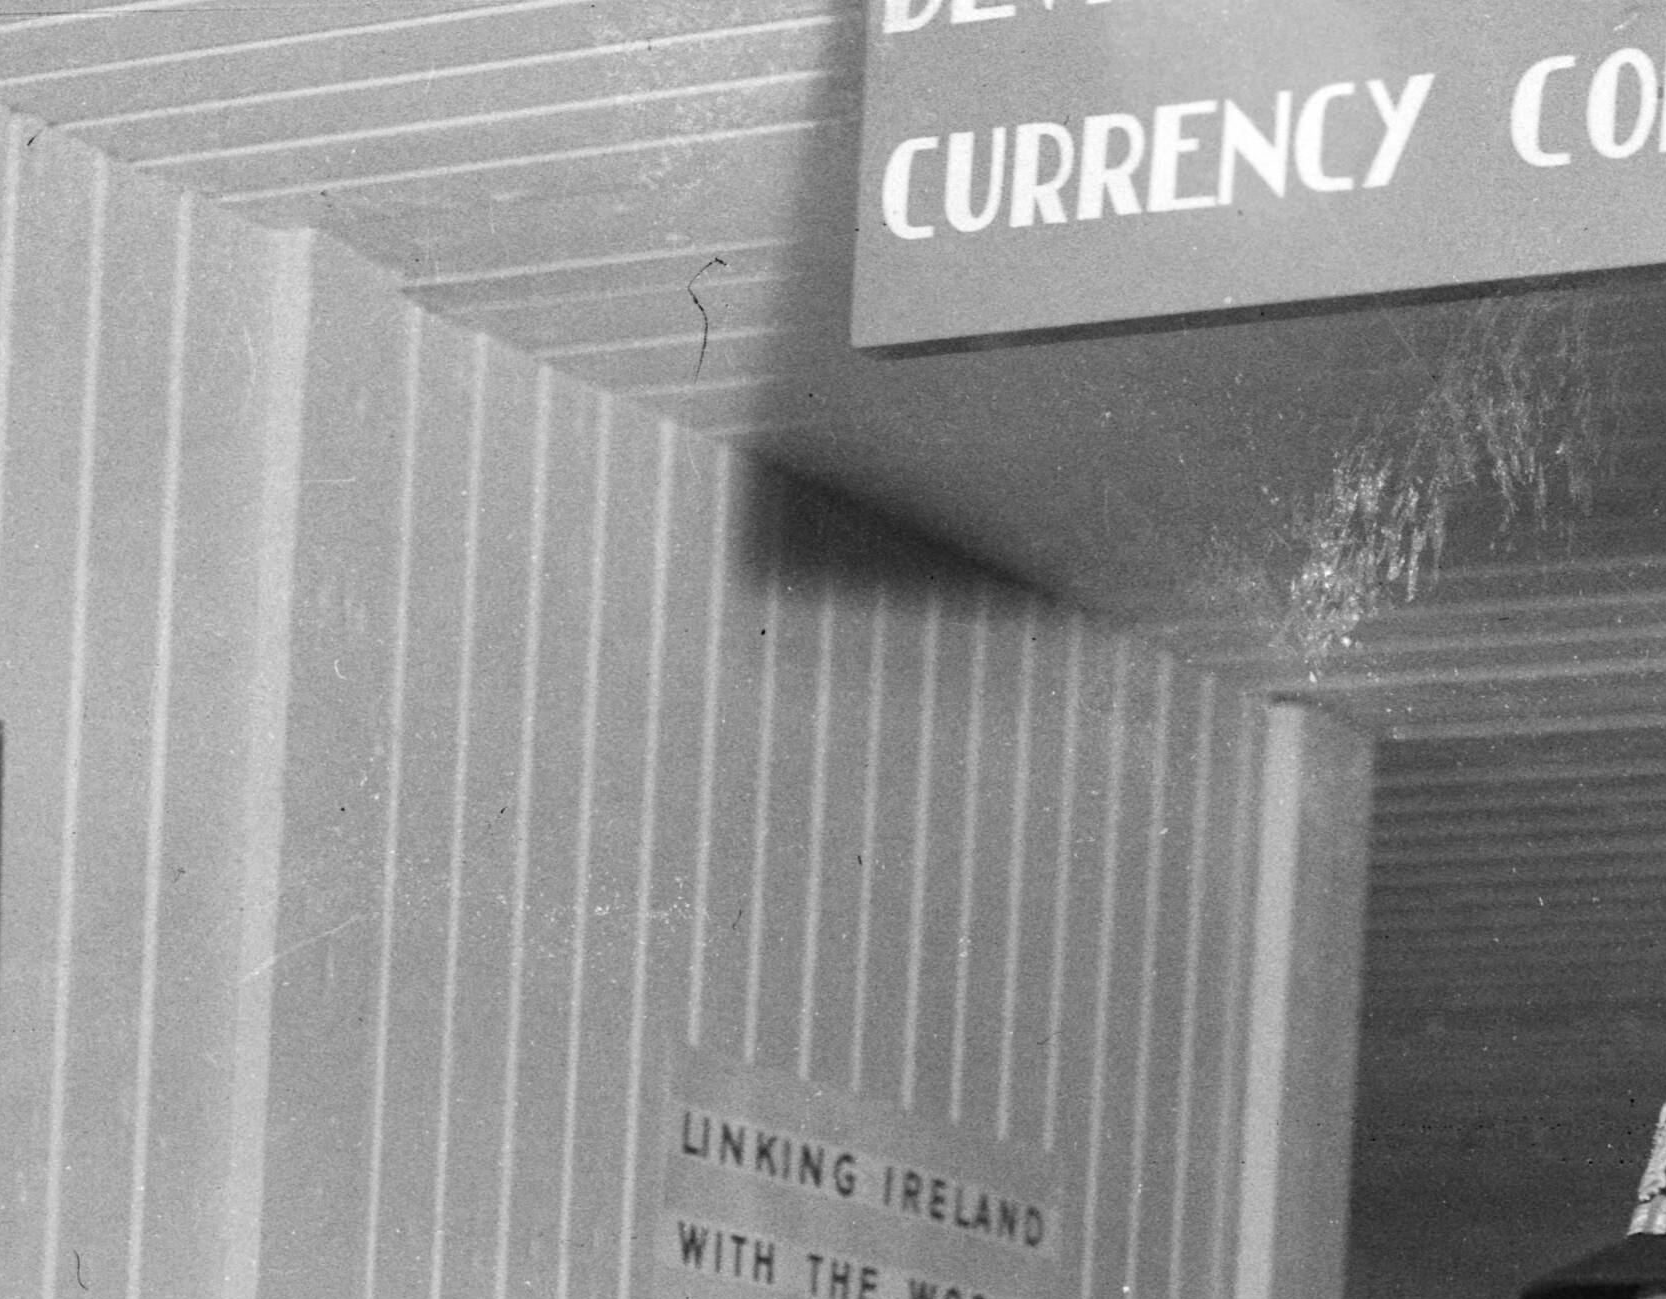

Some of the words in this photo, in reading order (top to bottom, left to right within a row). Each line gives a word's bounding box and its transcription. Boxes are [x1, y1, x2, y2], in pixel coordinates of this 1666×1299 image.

[881, 72, 1436, 240] CURRENCY
[681, 1110, 857, 1199] LINKING
[881, 1164, 1046, 1248] IRELAND
[677, 1220, 775, 1286] WITH
